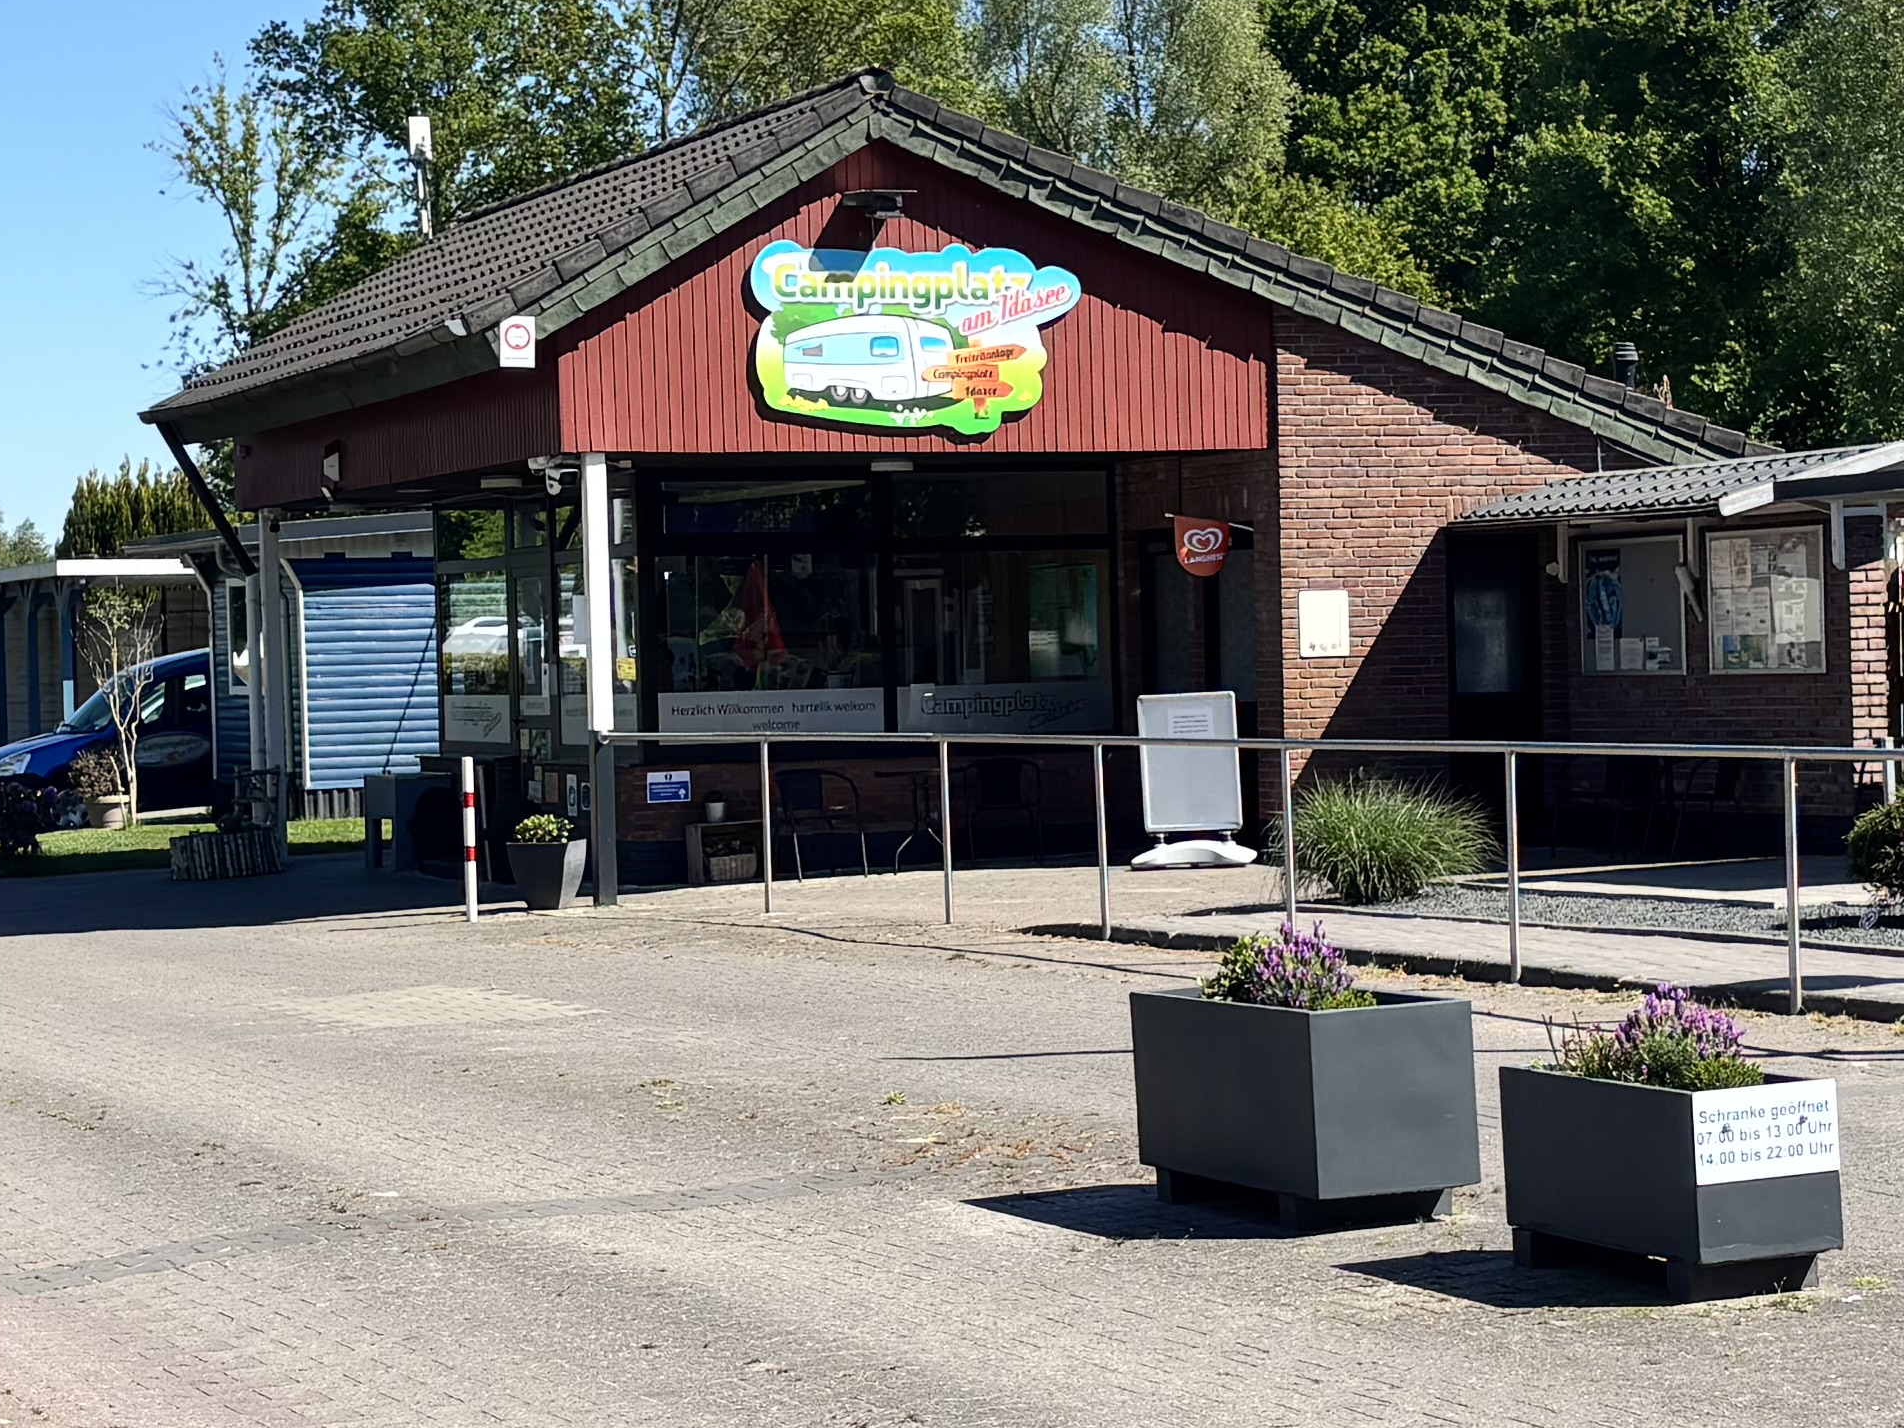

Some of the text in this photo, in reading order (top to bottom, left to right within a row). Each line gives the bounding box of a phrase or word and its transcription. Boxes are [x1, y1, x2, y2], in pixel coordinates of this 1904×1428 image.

[962, 285, 1066, 332] am Idasee
[672, 703, 715, 716] Herzlich
[1699, 1100, 1829, 1124] Schranke geöffnet
[1740, 1128, 1760, 1141] bis
[1808, 1121, 1832, 1134] Uhr
[1741, 1149, 1761, 1162] bis
[1809, 1141, 1834, 1155] Uhr
